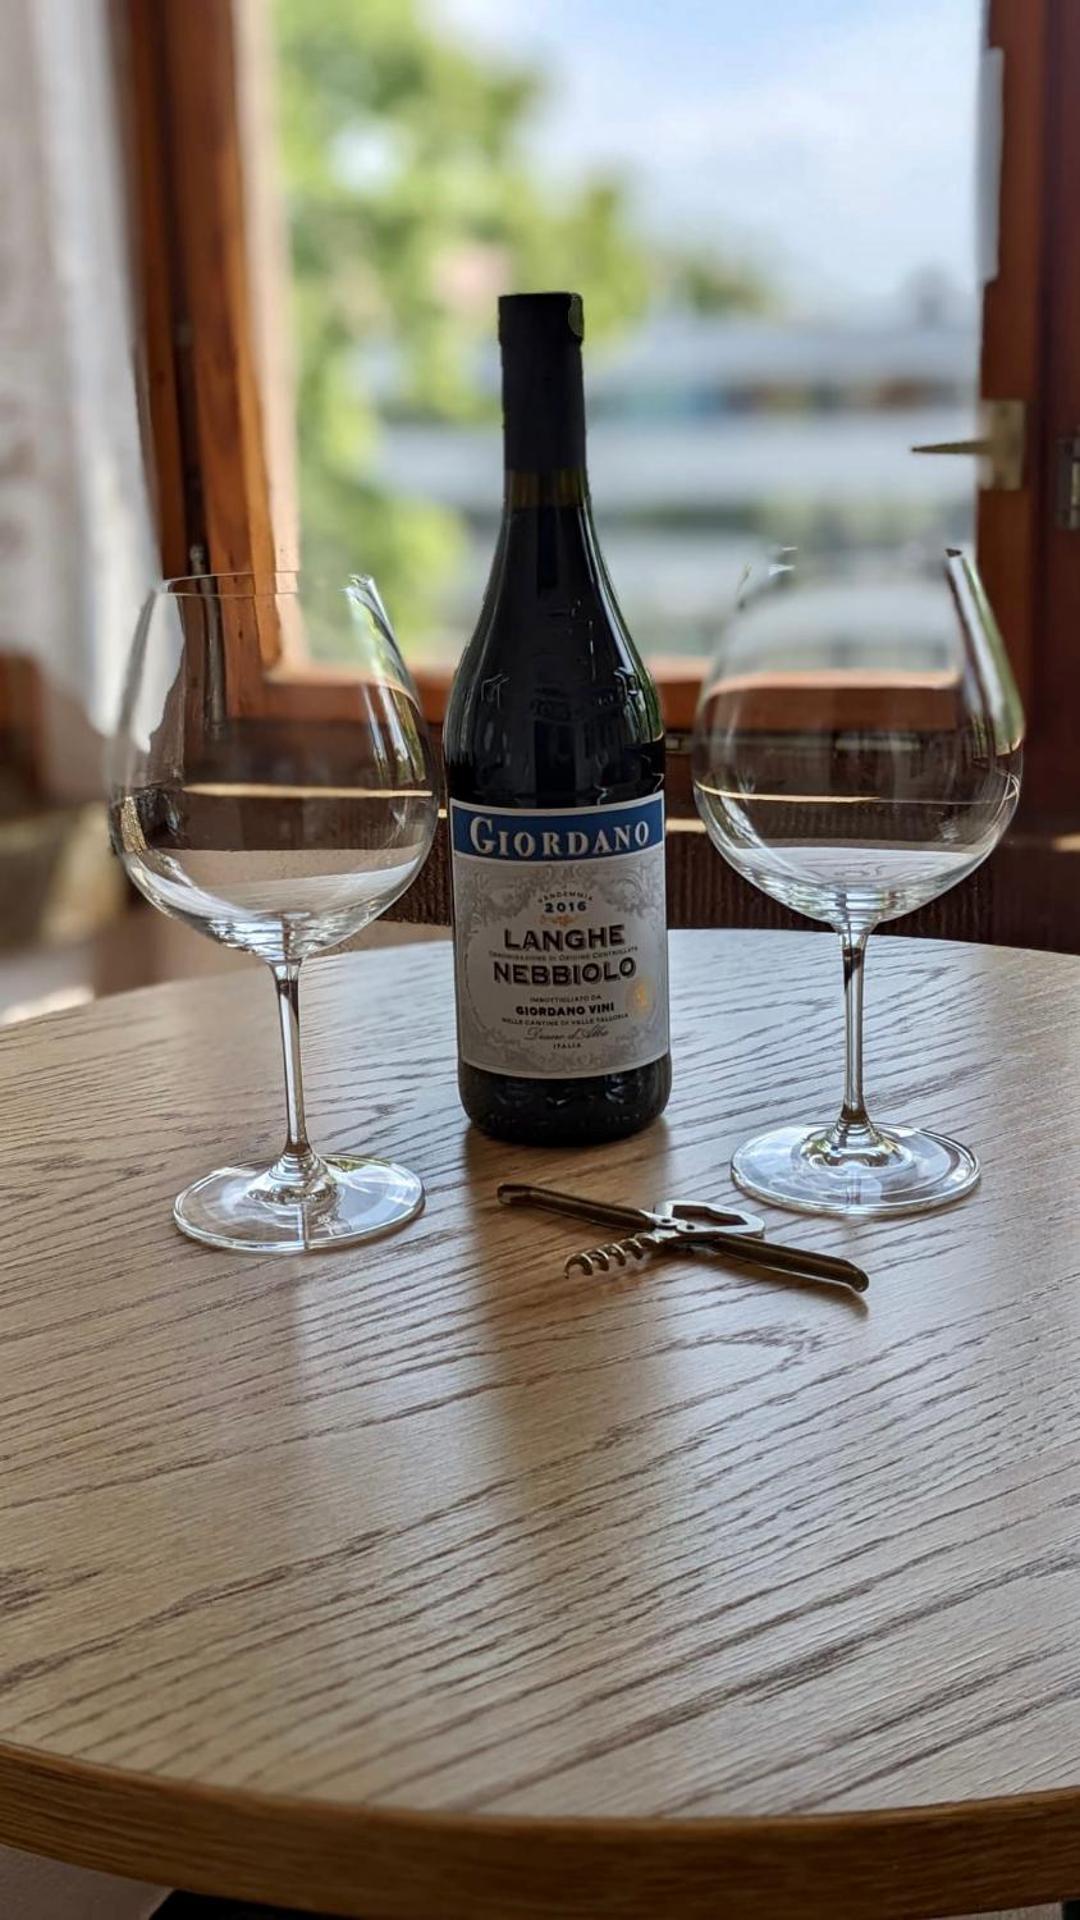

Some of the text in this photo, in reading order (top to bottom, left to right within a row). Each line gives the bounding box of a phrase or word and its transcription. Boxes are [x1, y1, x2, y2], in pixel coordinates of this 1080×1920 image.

[470, 815, 650, 858] GIORDANO
[544, 901, 587, 913] 2016
[504, 924, 625, 952] LANGHE
[493, 957, 637, 987] NEBBIOLO
[515, 1001, 614, 1017] GIORDANO VINI
